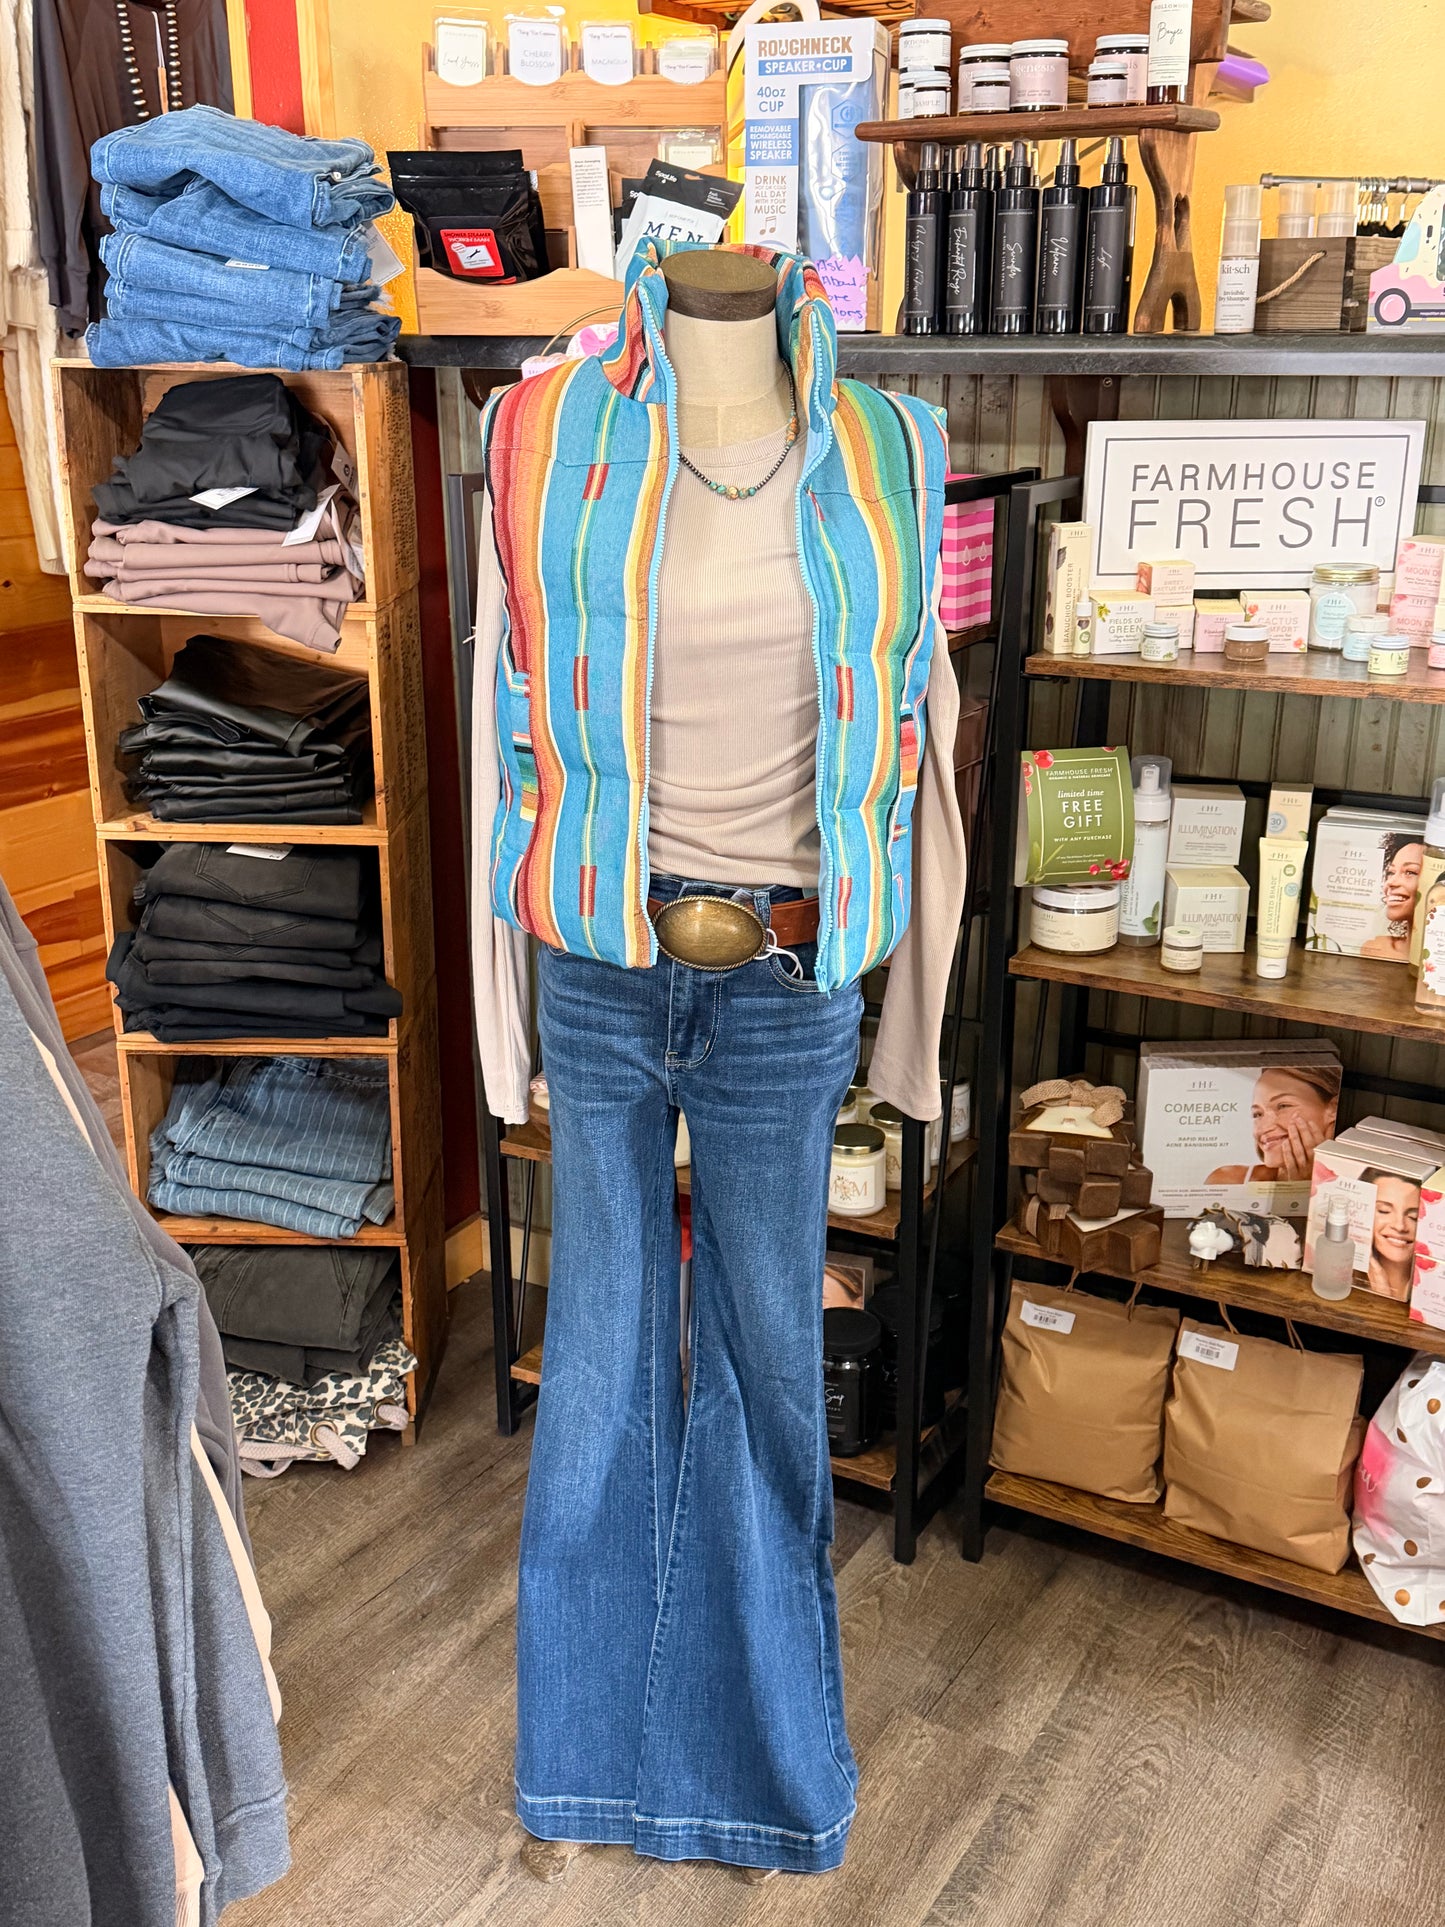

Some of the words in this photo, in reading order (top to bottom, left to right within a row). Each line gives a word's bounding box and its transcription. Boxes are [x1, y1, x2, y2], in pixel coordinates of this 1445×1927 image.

[758, 36, 852, 57] ROUGHNECK
[520, 59, 555, 68] BLOSSOM
[765, 60, 815, 74] SPEAKER
[822, 59, 847, 71] CUP
[1015, 64, 1056, 77] genesis
[757, 86, 786, 98] 40oz
[759, 101, 784, 112] CUP
[750, 140, 792, 150] WIRELESS
[750, 150, 792, 160] SPEAKER
[755, 175, 787, 185] DRINK
[754, 205, 787, 214] MUSIC
[643, 221, 705, 243] MEN
[817, 259, 845, 271] Ask
[828, 294, 851, 302] ore
[833, 307, 863, 319] lors
[1132, 462, 1376, 491] FARMHOUSE
[1406, 567, 1430, 576] MOON
[1066, 563, 1074, 598] BOOSTER
[1063, 601, 1072, 643] BAKUCHIOL
[1258, 617, 1298, 625] CACTUS
[1397, 618, 1421, 626] MOON
[1109, 626, 1143, 634] GREEN
[1057, 790, 1085, 798] limited
[1062, 800, 1103, 813] FREE
[1064, 815, 1103, 828] GIFT
[1270, 818, 1281, 826] 30
[1178, 824, 1238, 836] ILLUMINATION
[1336, 866, 1367, 877] CROW
[1269, 876, 1278, 900] SHADE
[1182, 914, 1242, 924] ILLUMINATION
[1266, 900, 1275, 933] ELEVATED
[1164, 1102, 1238, 1113] COMEBACK
[1179, 1116, 1222, 1125] CLEAR
